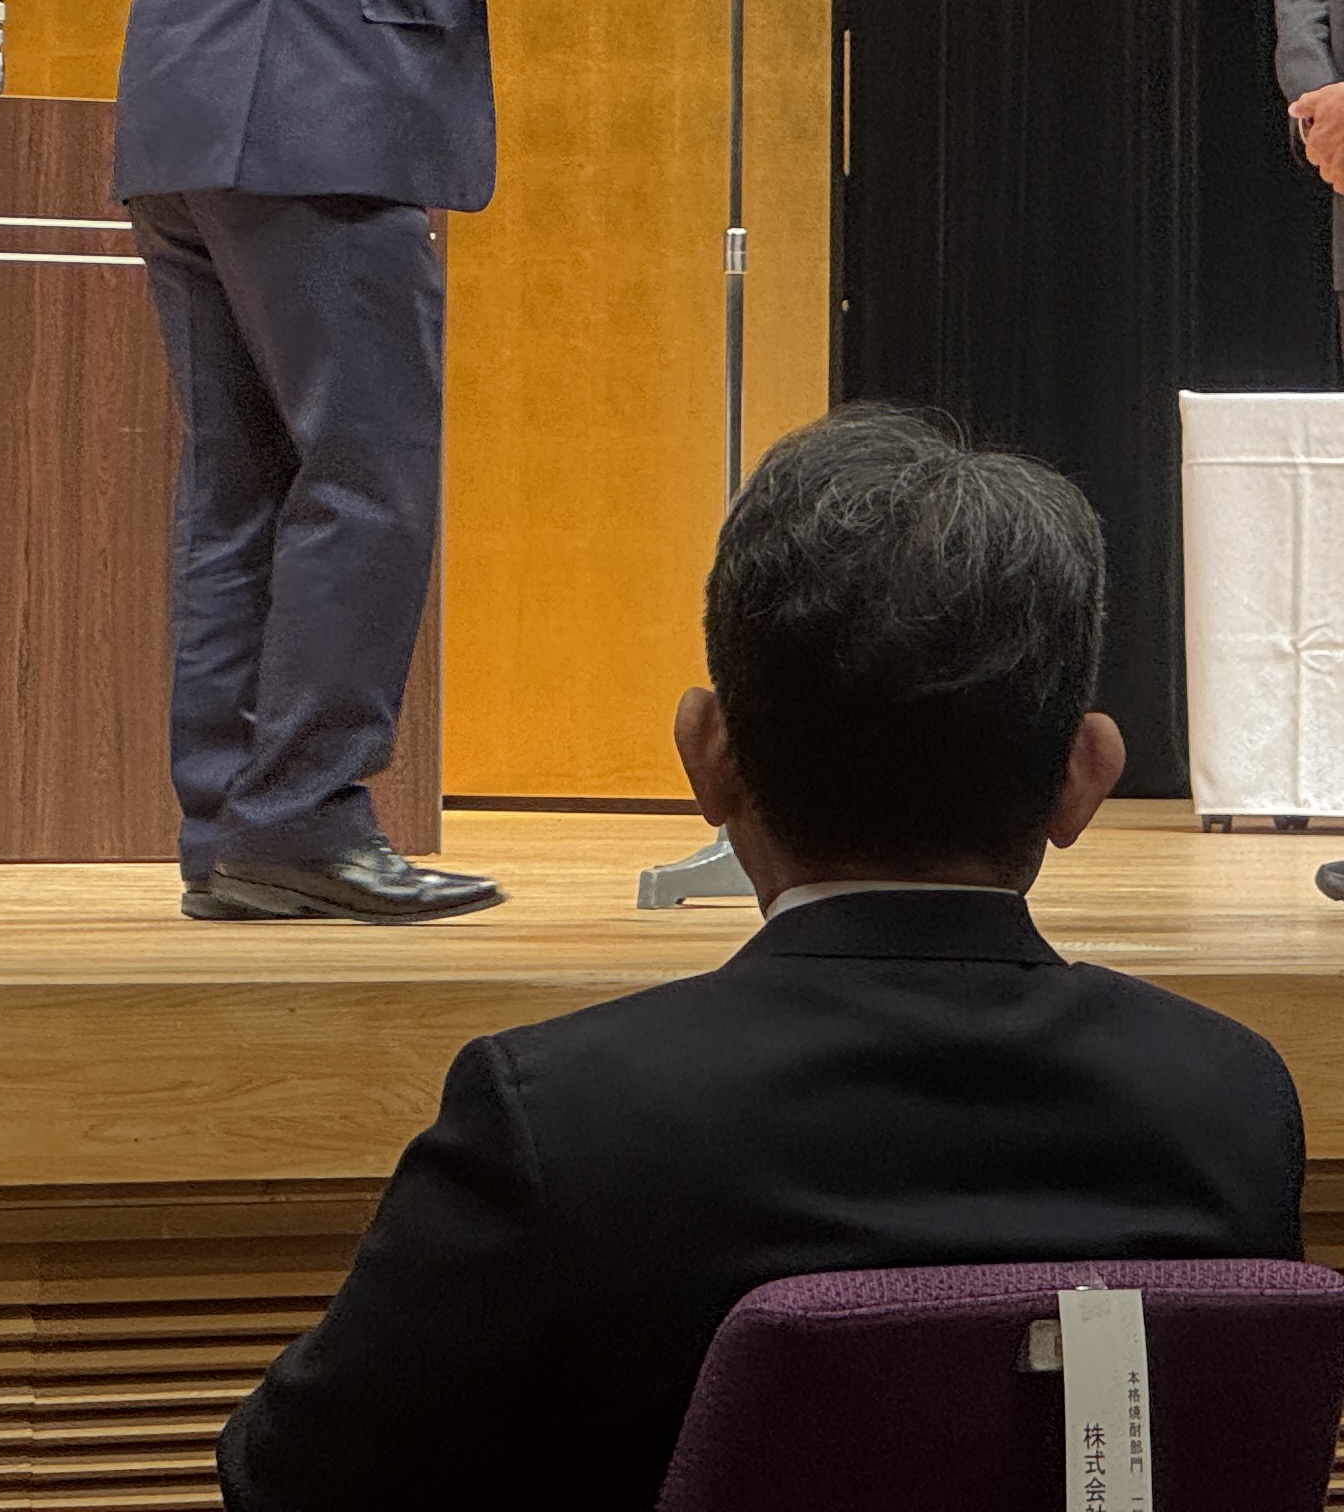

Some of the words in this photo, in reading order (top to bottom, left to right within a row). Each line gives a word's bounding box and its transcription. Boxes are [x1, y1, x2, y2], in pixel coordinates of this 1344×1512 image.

[1128, 1371, 1143, 1473] 本格焼酎部門
